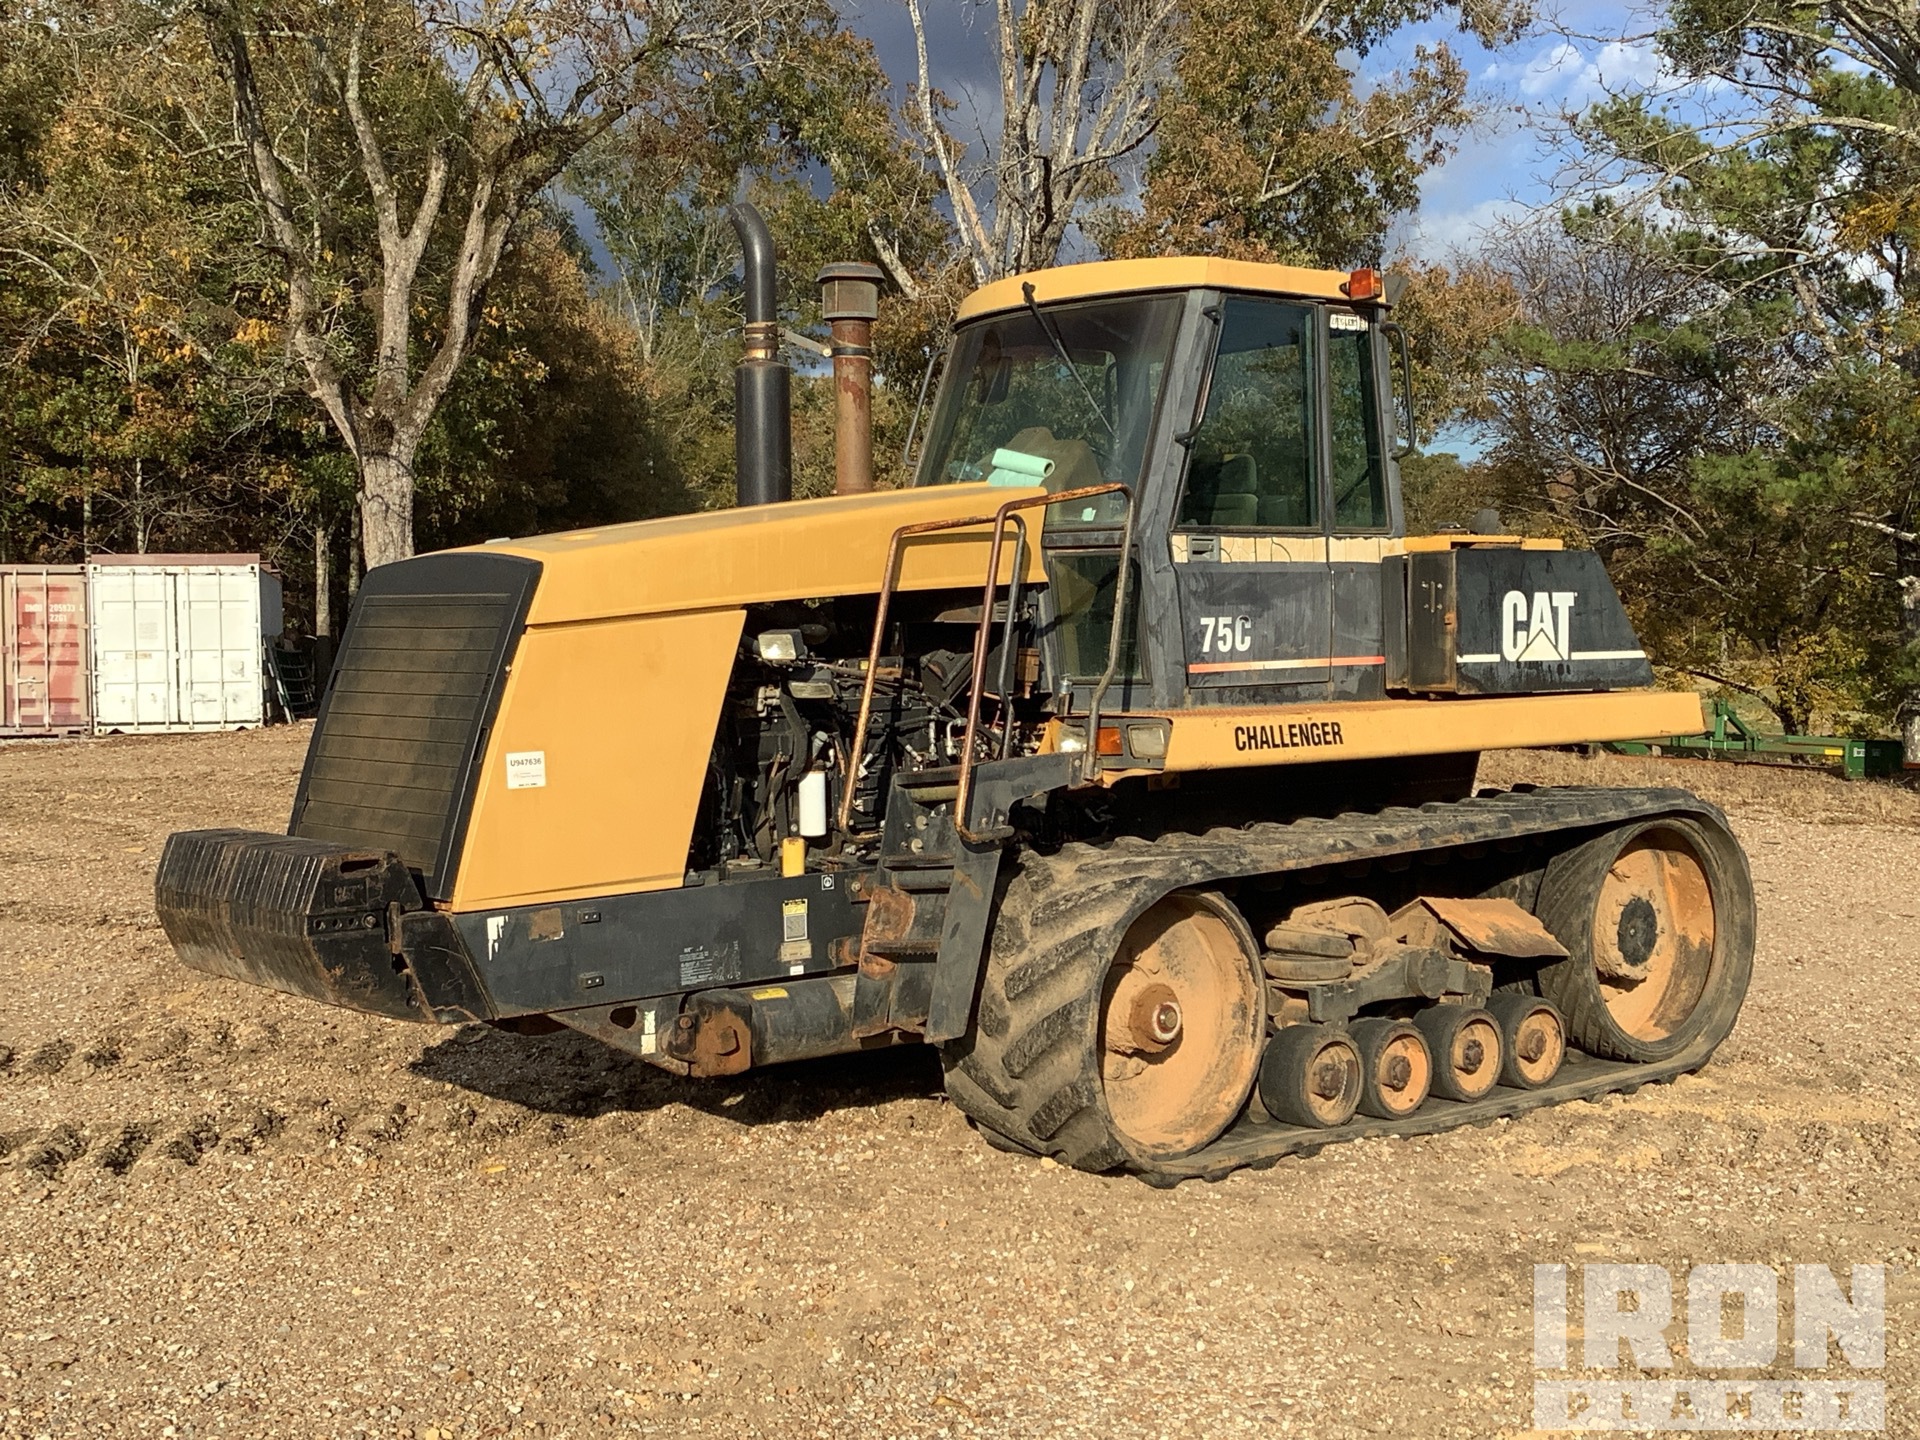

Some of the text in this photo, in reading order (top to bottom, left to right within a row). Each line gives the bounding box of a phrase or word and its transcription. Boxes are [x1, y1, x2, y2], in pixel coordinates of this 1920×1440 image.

[1200, 615, 1252, 653] 75C
[1502, 590, 1575, 662] CAT
[1234, 722, 1344, 751] CHALLENGER
[510, 757, 542, 767] U947636
